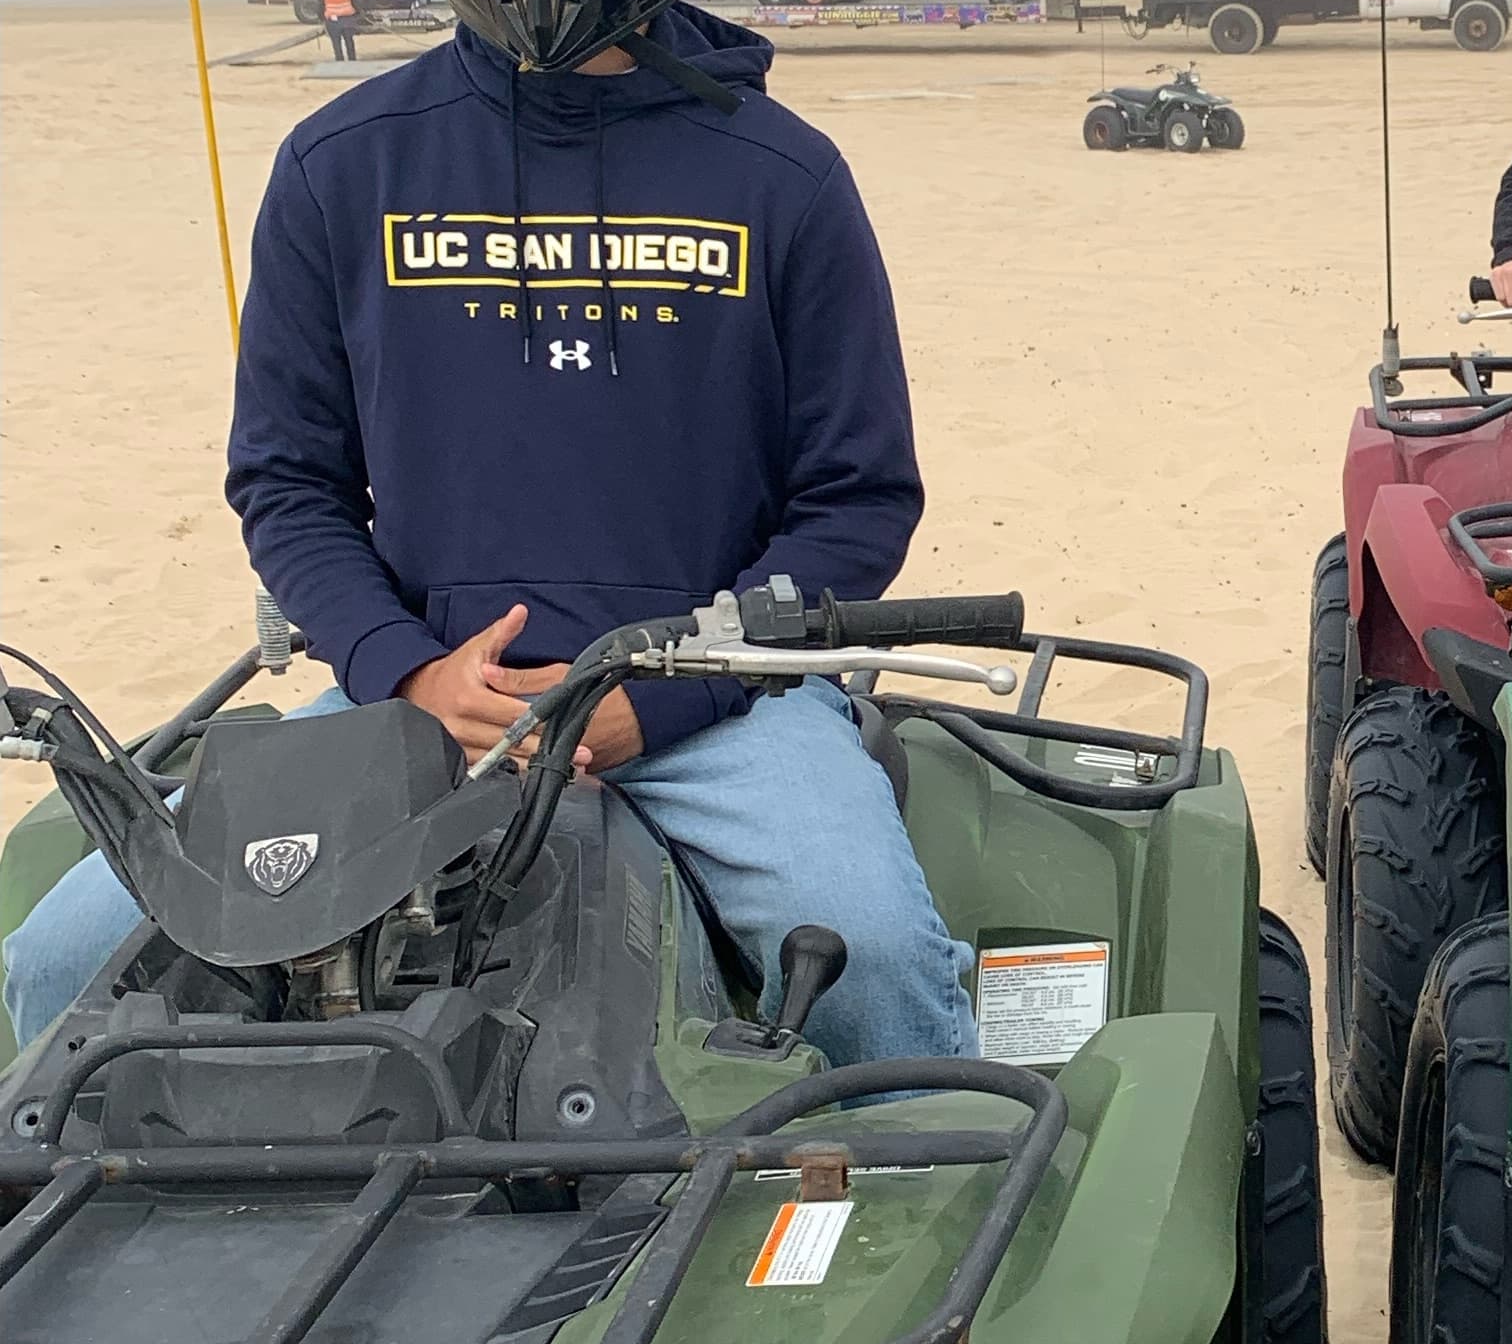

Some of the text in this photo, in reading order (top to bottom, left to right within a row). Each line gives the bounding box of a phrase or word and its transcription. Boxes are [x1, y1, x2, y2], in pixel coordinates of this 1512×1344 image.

[403, 231, 730, 277] UC SAN DIEGO
[464, 302, 675, 323] TRITONS
